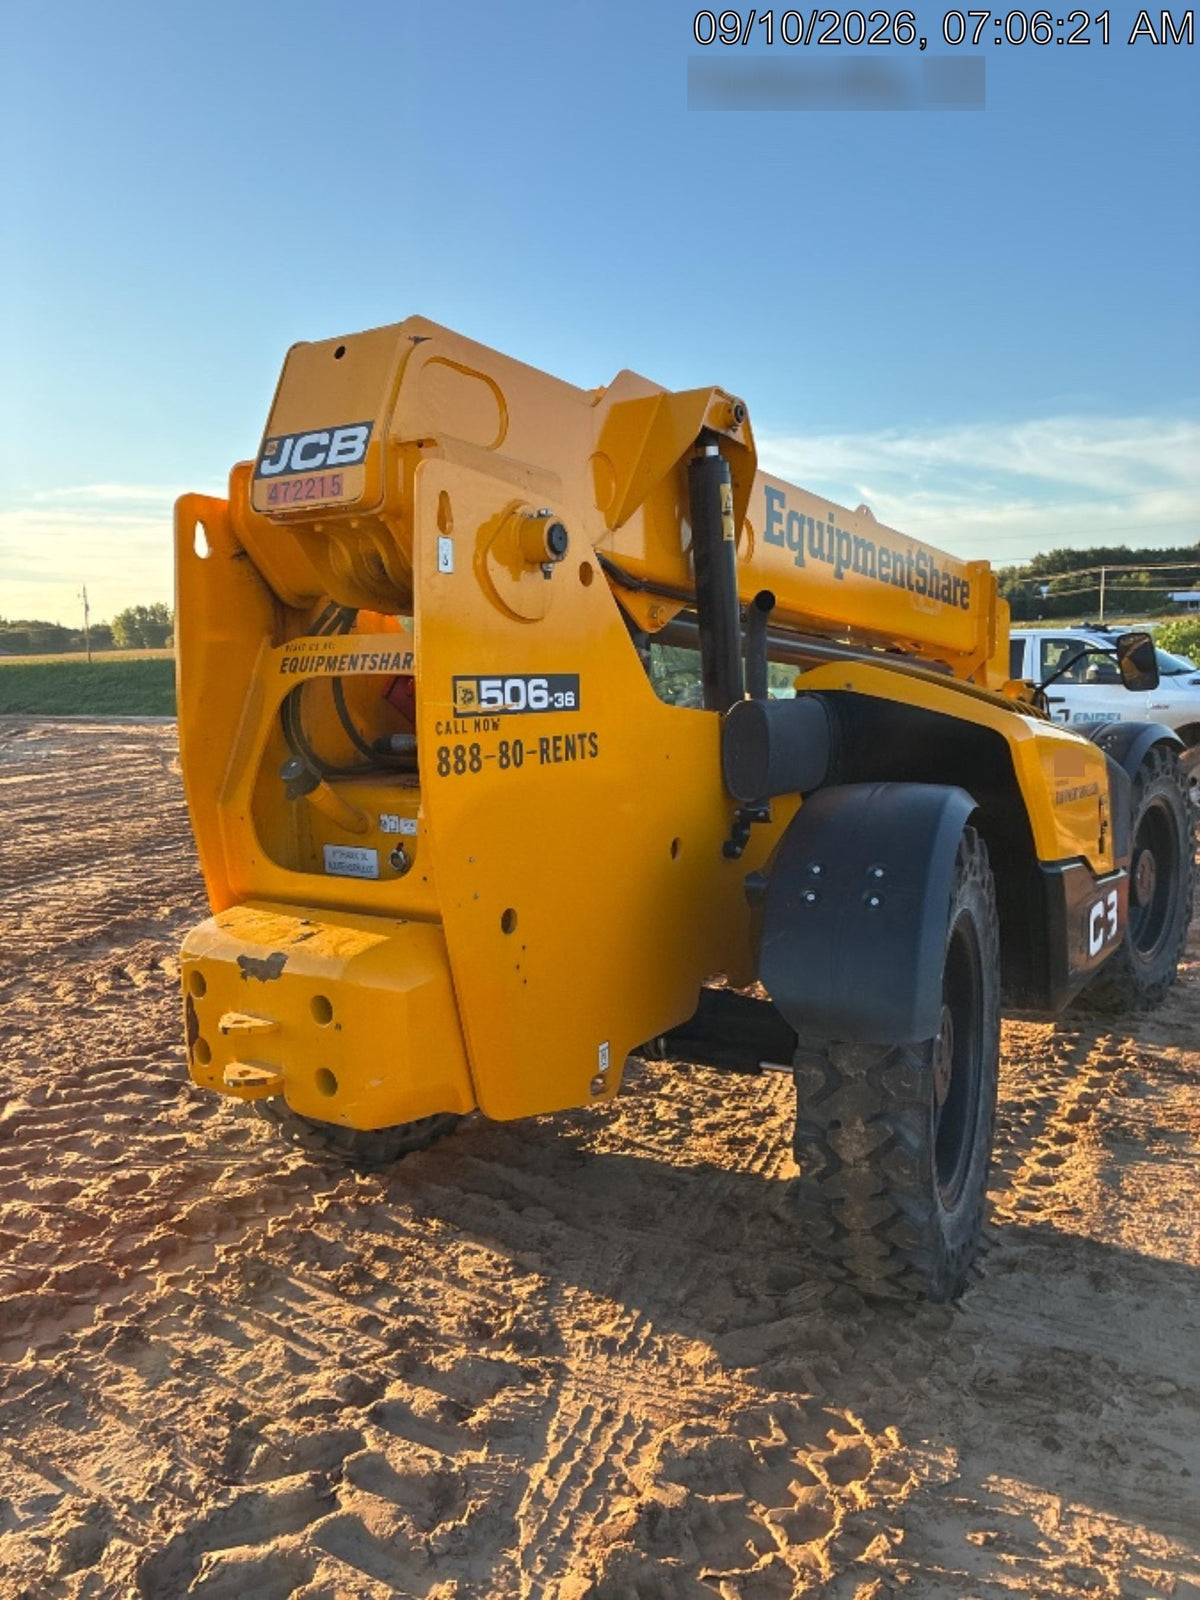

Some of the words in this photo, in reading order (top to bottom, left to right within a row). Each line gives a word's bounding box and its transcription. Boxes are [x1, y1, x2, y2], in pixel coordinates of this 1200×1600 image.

[260, 426, 369, 475] JCB
[268, 474, 342, 504] 472215
[764, 485, 970, 610] EquipmentShare
[279, 651, 415, 674] EQUIPMENTSHAR
[435, 720, 468, 735] CALL
[474, 717, 500, 733] NOW
[437, 732, 598, 777] 888-80-RENTS
[1089, 889, 1118, 957] C3
